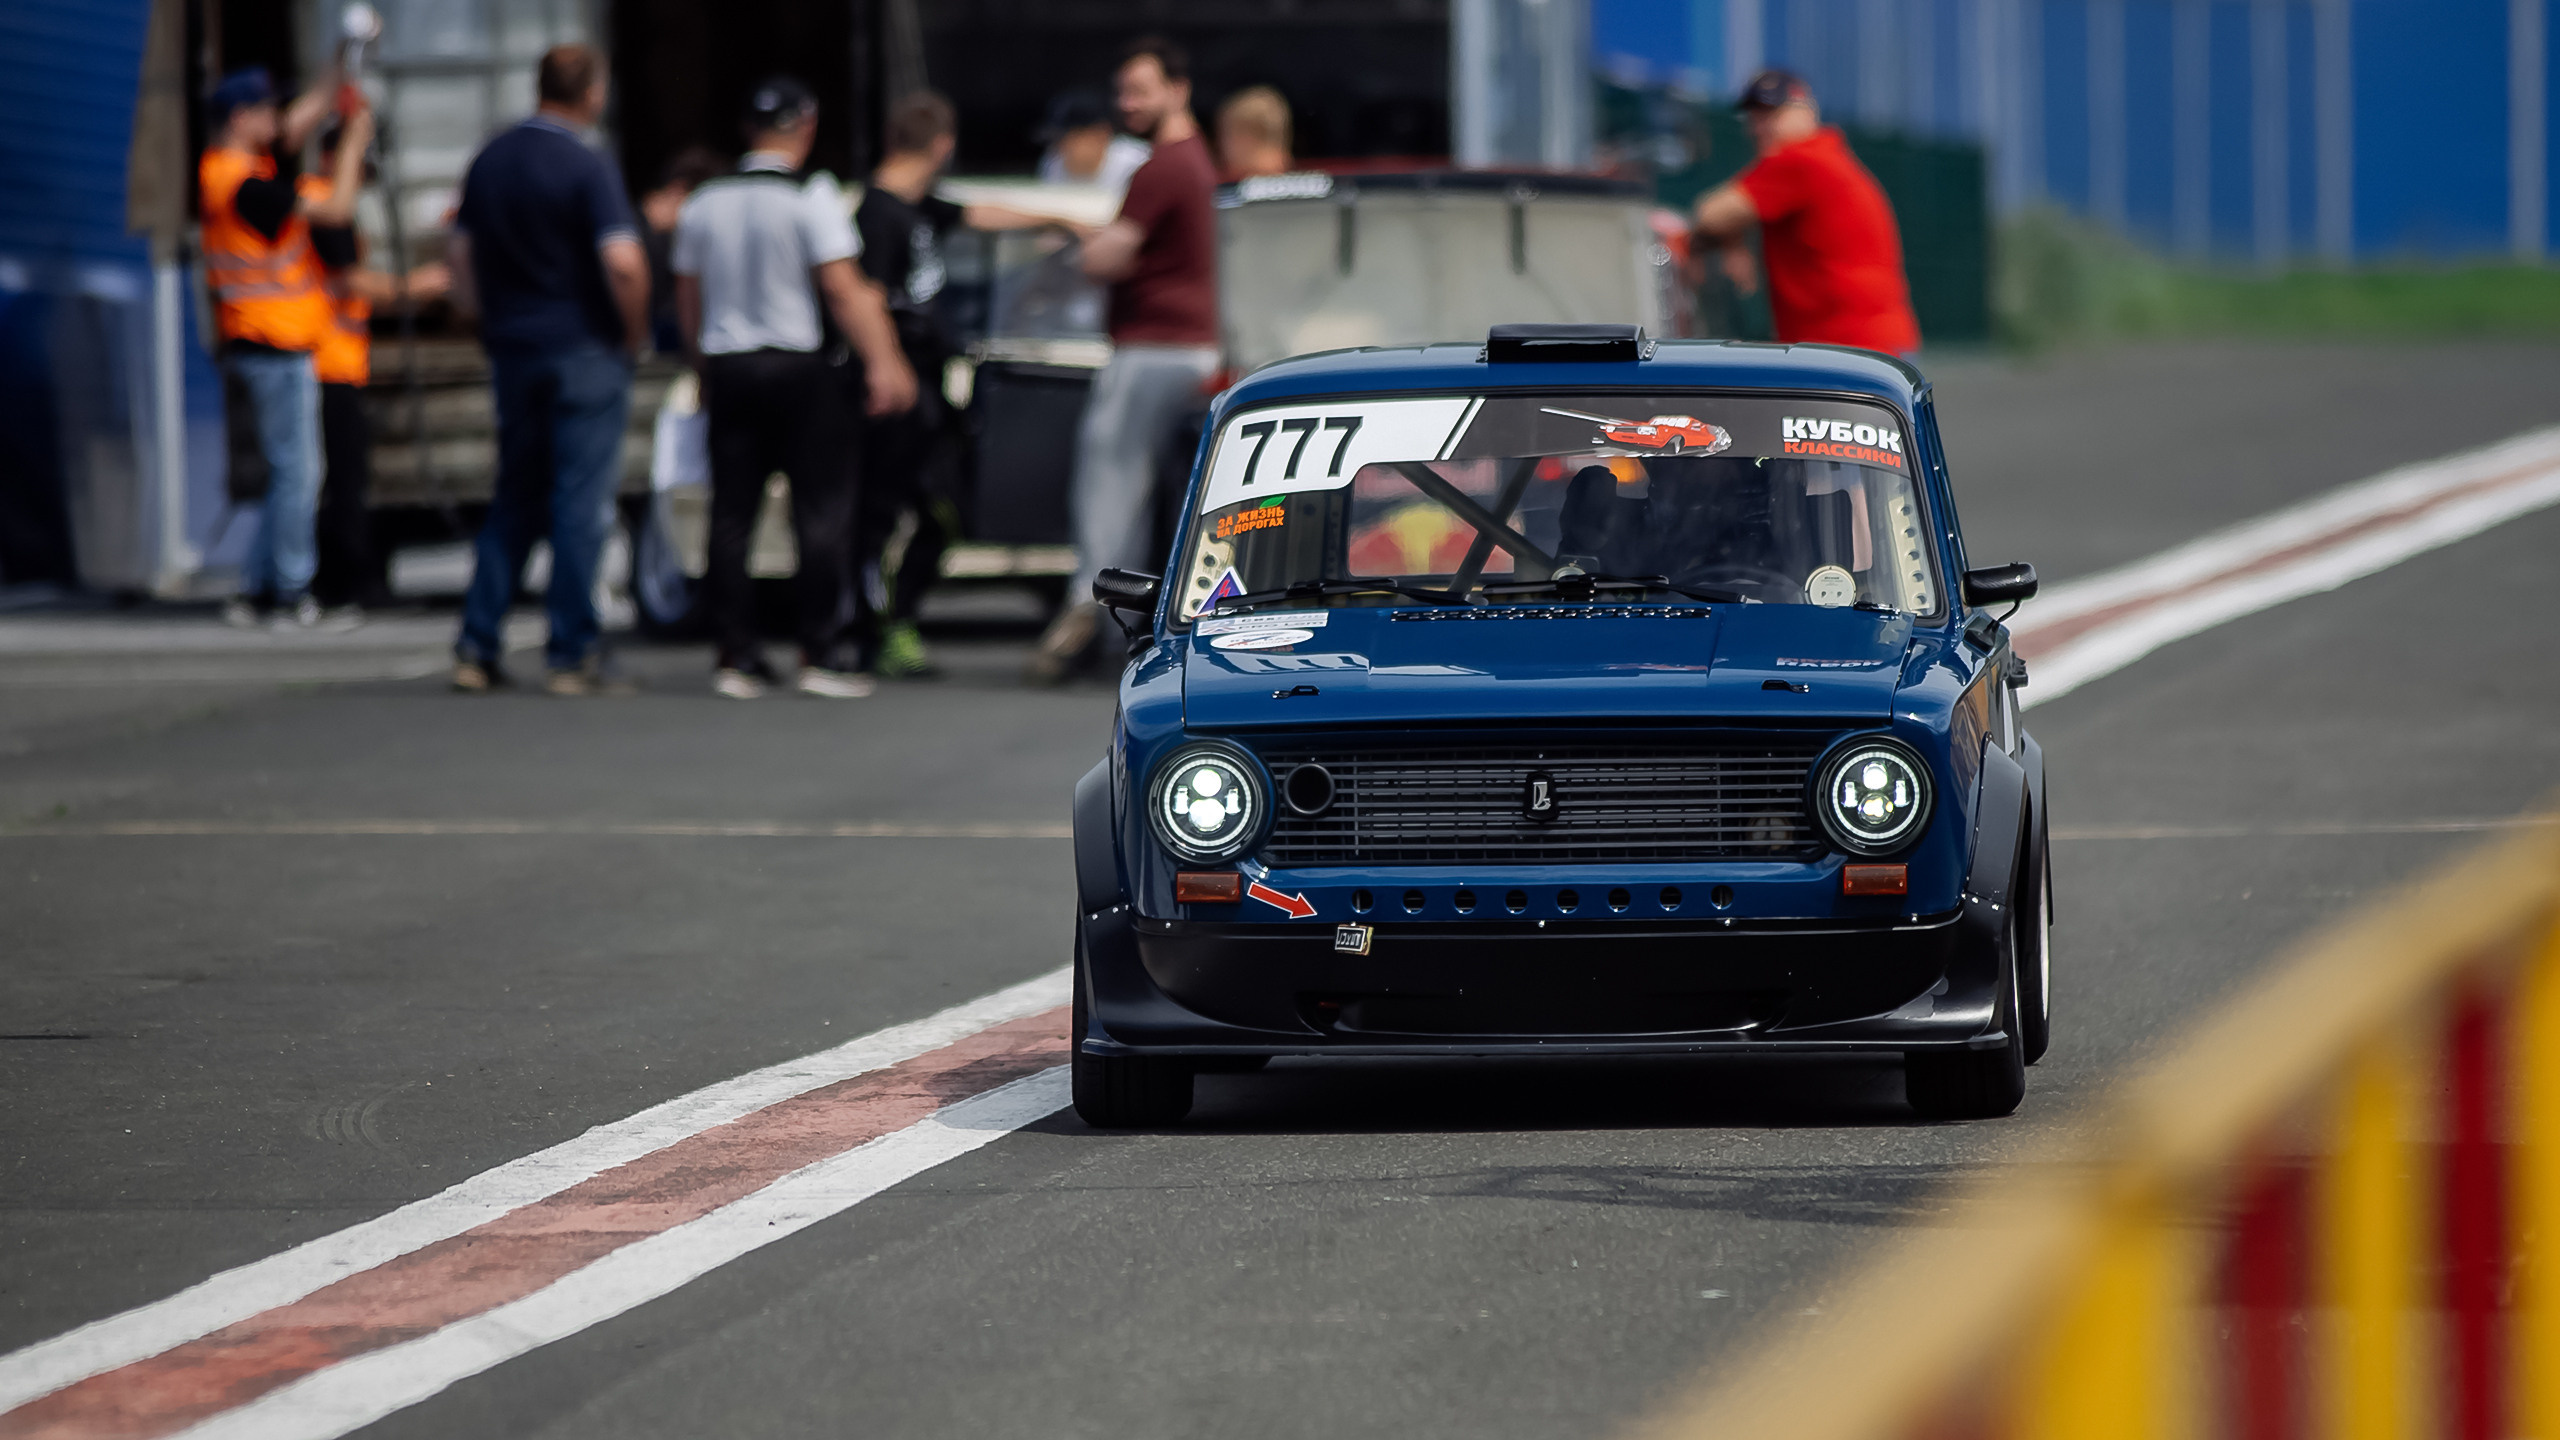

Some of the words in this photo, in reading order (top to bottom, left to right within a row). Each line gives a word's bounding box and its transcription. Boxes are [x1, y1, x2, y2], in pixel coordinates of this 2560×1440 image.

[1782, 417, 1901, 453] КУБОК
[1240, 416, 1363, 486] 777
[1784, 441, 1901, 468] КЛАССИКИ
[1217, 515, 1233, 529] ЗА
[1237, 506, 1285, 524] ЖИЗНЬ
[1233, 517, 1284, 536] ДОРОГАХ
